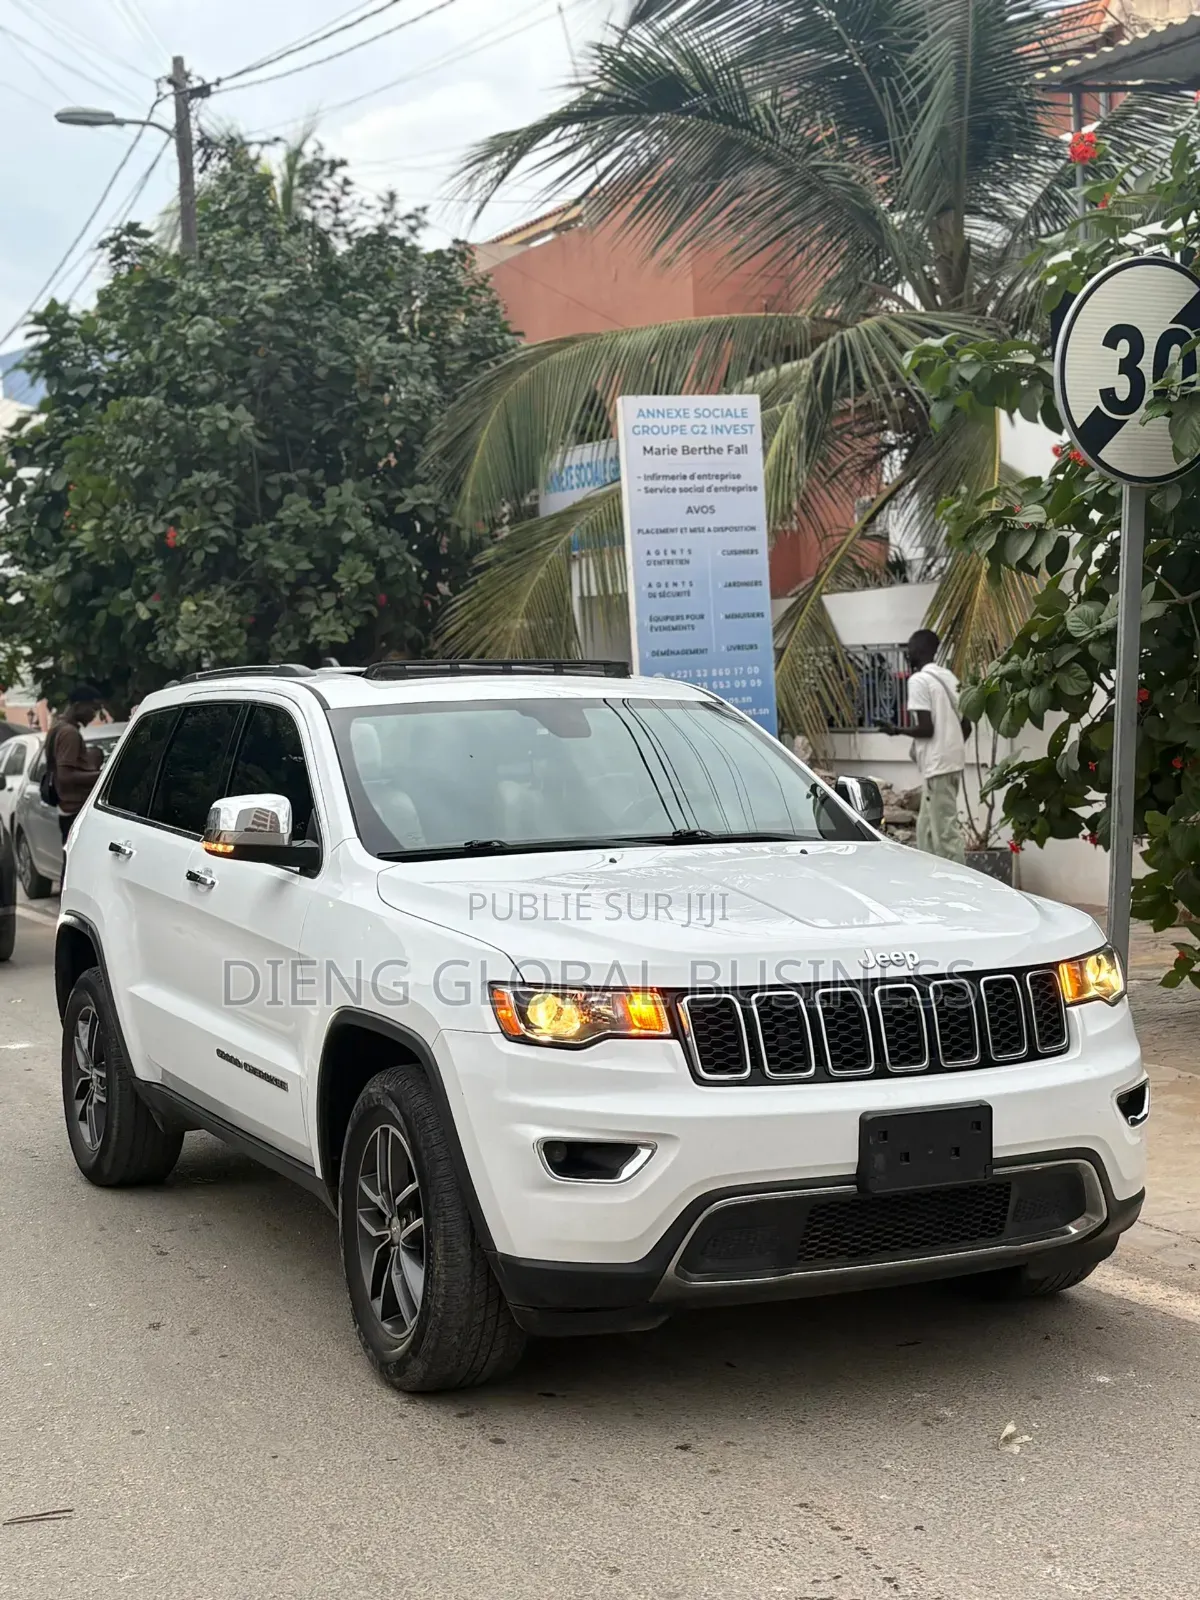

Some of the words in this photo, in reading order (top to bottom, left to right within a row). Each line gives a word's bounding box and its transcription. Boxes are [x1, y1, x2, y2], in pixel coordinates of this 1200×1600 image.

[1099, 323, 1197, 416] 30
[637, 408, 691, 419] ANNEXE
[694, 408, 749, 419] SOCIALE
[632, 424, 688, 436] GROUPE
[691, 424, 708, 436] G2
[711, 424, 755, 435] INVEST
[643, 445, 678, 456] Marie
[681, 444, 724, 456] Berthe
[727, 444, 748, 455] Fall
[643, 472, 687, 482] Infirmerie
[644, 486, 677, 494] Service
[678, 485, 705, 494] social
[685, 505, 716, 515] AVOS
[637, 527, 678, 536] PLACEMENT
[679, 526, 688, 534] ET
[689, 526, 705, 534] MISE
[712, 525, 757, 533] DISPOSITION
[648, 591, 657, 599] DE
[686, 613, 705, 621] POUR
[724, 611, 765, 620] MENUISIERS
[726, 643, 758, 652] LIVREURS
[734, 667, 744, 676] 17
[858, 948, 920, 970] Jeep
